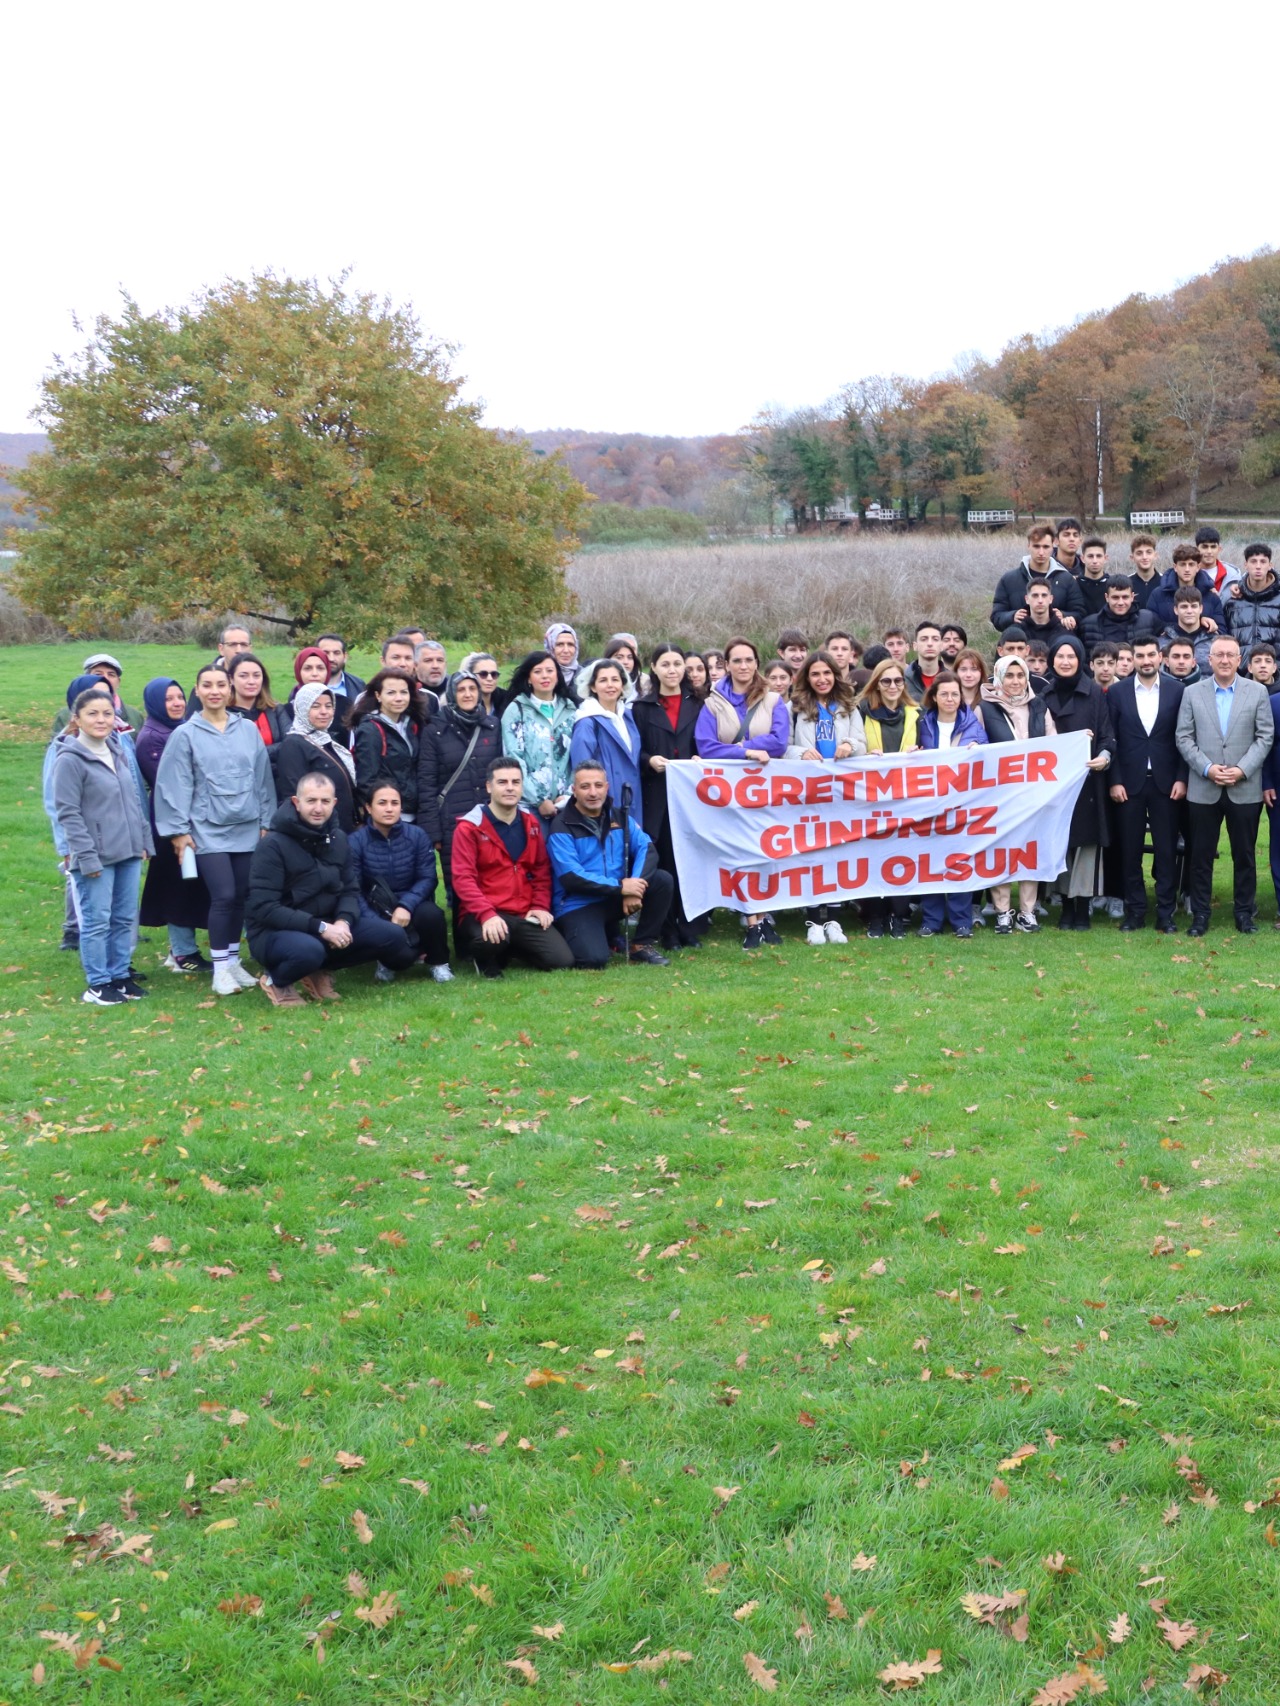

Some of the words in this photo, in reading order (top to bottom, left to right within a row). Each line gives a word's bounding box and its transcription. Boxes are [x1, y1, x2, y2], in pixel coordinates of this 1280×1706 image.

[696, 751, 1058, 809] ÖĞRETMENLER
[760, 806, 998, 859] GÜNÜNÜZ
[719, 857, 869, 902] KUTLU
[881, 841, 1037, 886] OLSUN
